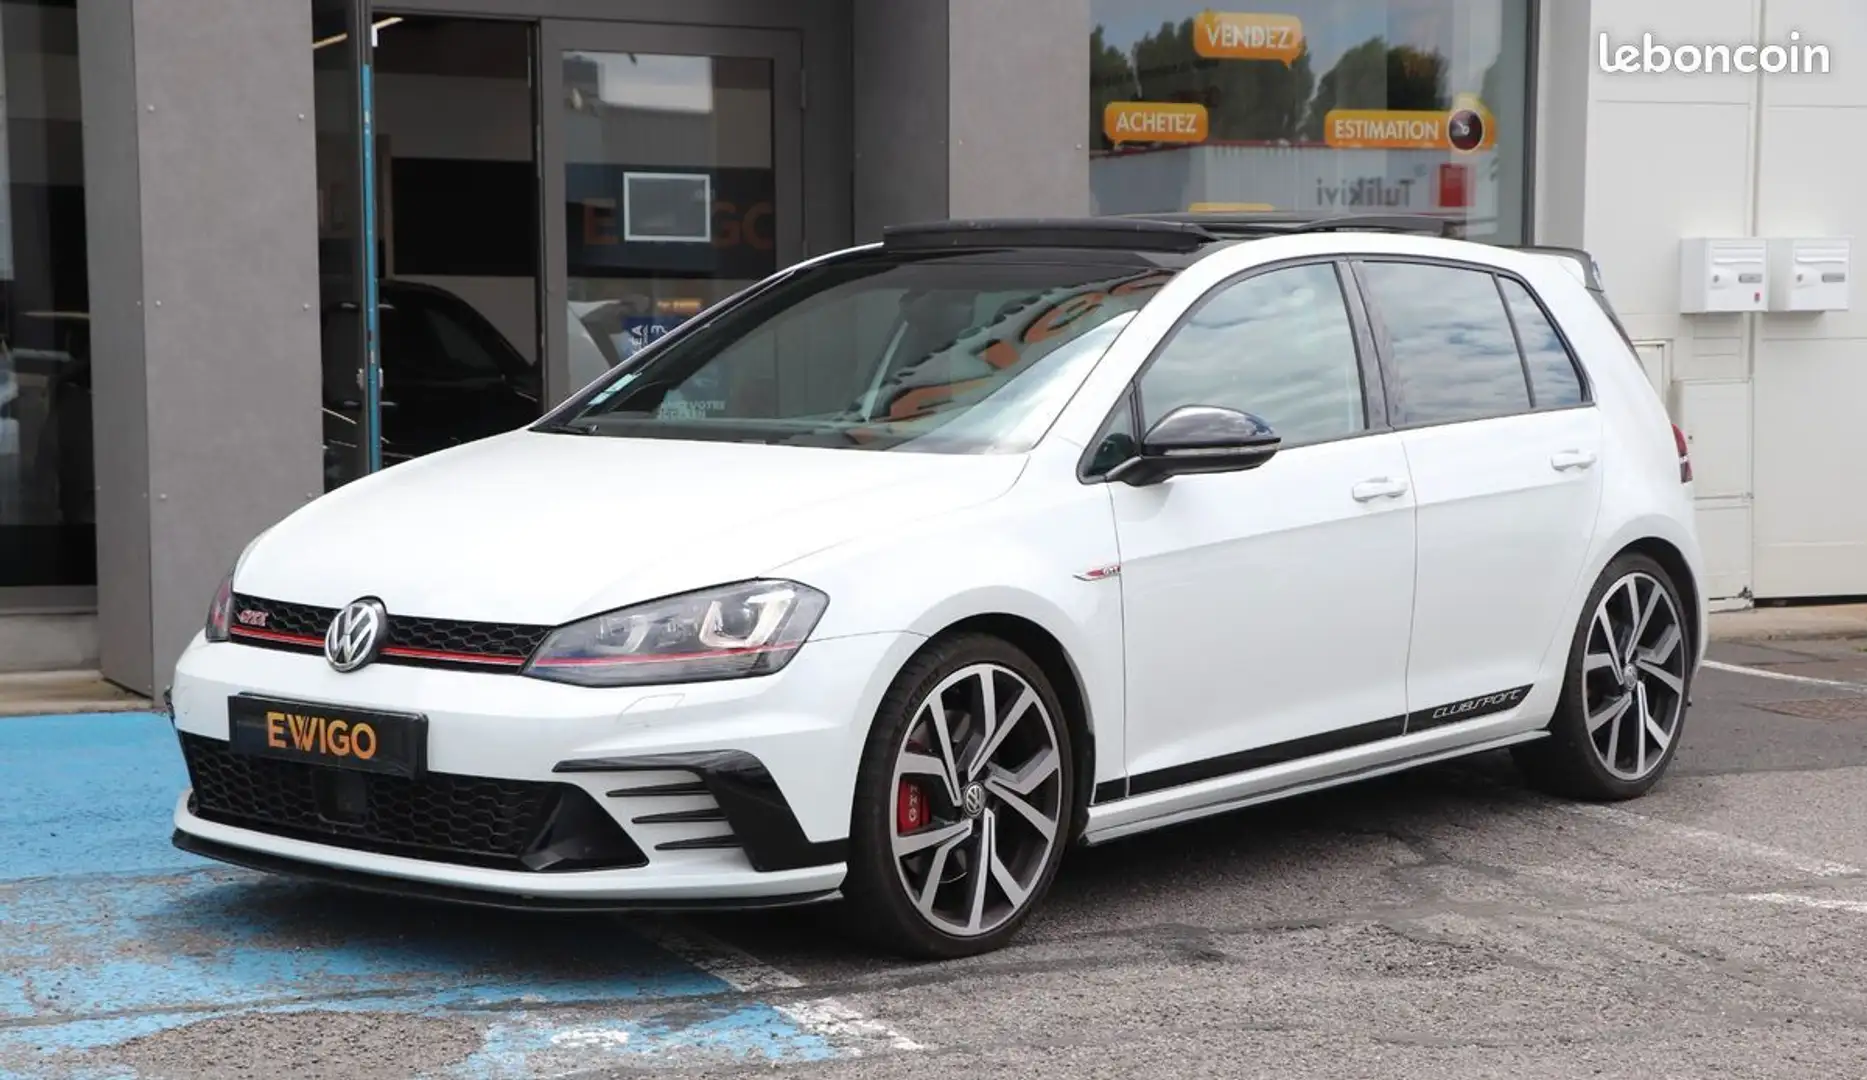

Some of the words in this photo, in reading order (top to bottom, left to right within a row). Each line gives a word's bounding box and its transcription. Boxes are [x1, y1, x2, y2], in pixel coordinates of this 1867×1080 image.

[1205, 24, 1292, 49] VENDEZ
[1115, 111, 1197, 133] ACHETEZ
[1334, 119, 1440, 141] ESTIMATION
[1432, 689, 1522, 719] CLUBSPORT
[266, 711, 377, 760] EWIGO
